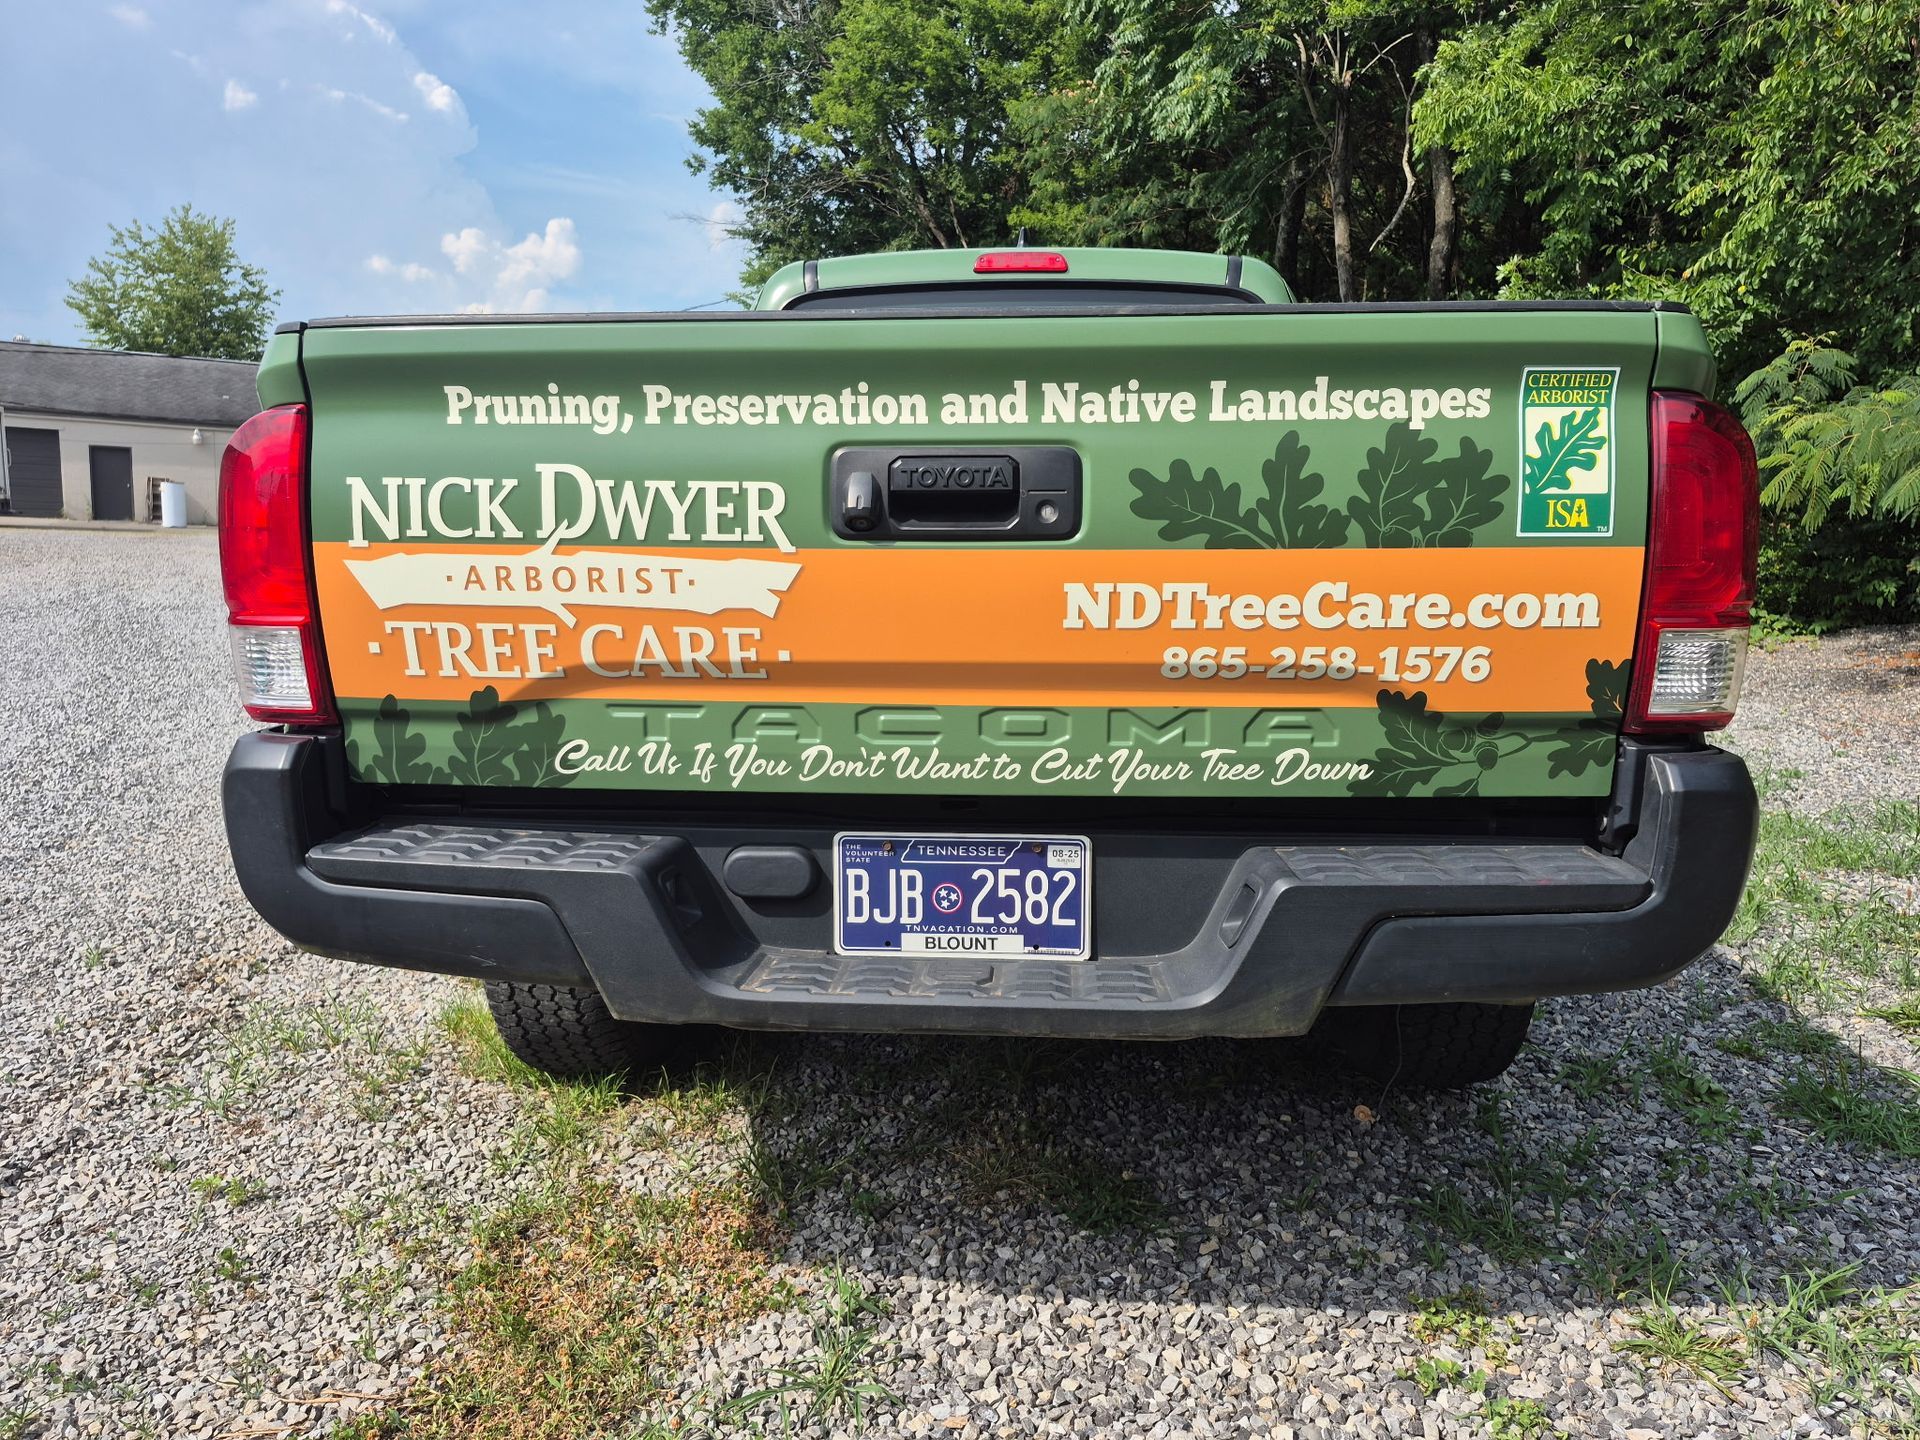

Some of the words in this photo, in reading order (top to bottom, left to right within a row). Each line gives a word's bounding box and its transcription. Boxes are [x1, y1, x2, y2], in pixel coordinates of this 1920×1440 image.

[1528, 373, 1612, 388] CERTIFIED
[444, 383, 634, 435] Pruning,
[643, 381, 929, 425] Preservation
[940, 380, 1028, 424] and
[1041, 379, 1196, 424] Native
[1209, 376, 1492, 431] Landscapes
[1527, 389, 1609, 404] ARBORIST
[901, 466, 1009, 489] TOYOTA
[346, 476, 524, 549] NICK
[534, 463, 797, 554] DWYER
[1545, 498, 1590, 528] ISA
[463, 564, 684, 595] ARBORIST
[1062, 581, 1600, 630] NDTreeCare.com
[384, 620, 566, 680] TREE
[579, 623, 768, 680] CARE
[1160, 645, 1492, 683] 865-258-1576
[605, 703, 1340, 746] TACOMA
[554, 739, 633, 775] Call
[637, 742, 682, 775] Us
[688, 742, 718, 784] If
[724, 744, 792, 788] You
[891, 747, 990, 785] Want
[991, 752, 1022, 779] to
[1030, 748, 1102, 784] Cut
[1106, 748, 1194, 794] Your
[1200, 748, 1266, 782] Tree
[1270, 748, 1375, 786] Down
[917, 845, 1006, 857] TENNESSEE
[1052, 849, 1080, 858] 08-25
[846, 868, 923, 924] BJB
[971, 869, 1076, 926] 2582
[906, 924, 1018, 934] TNVACATION.COM
[924, 936, 999, 951] BLOUNT
